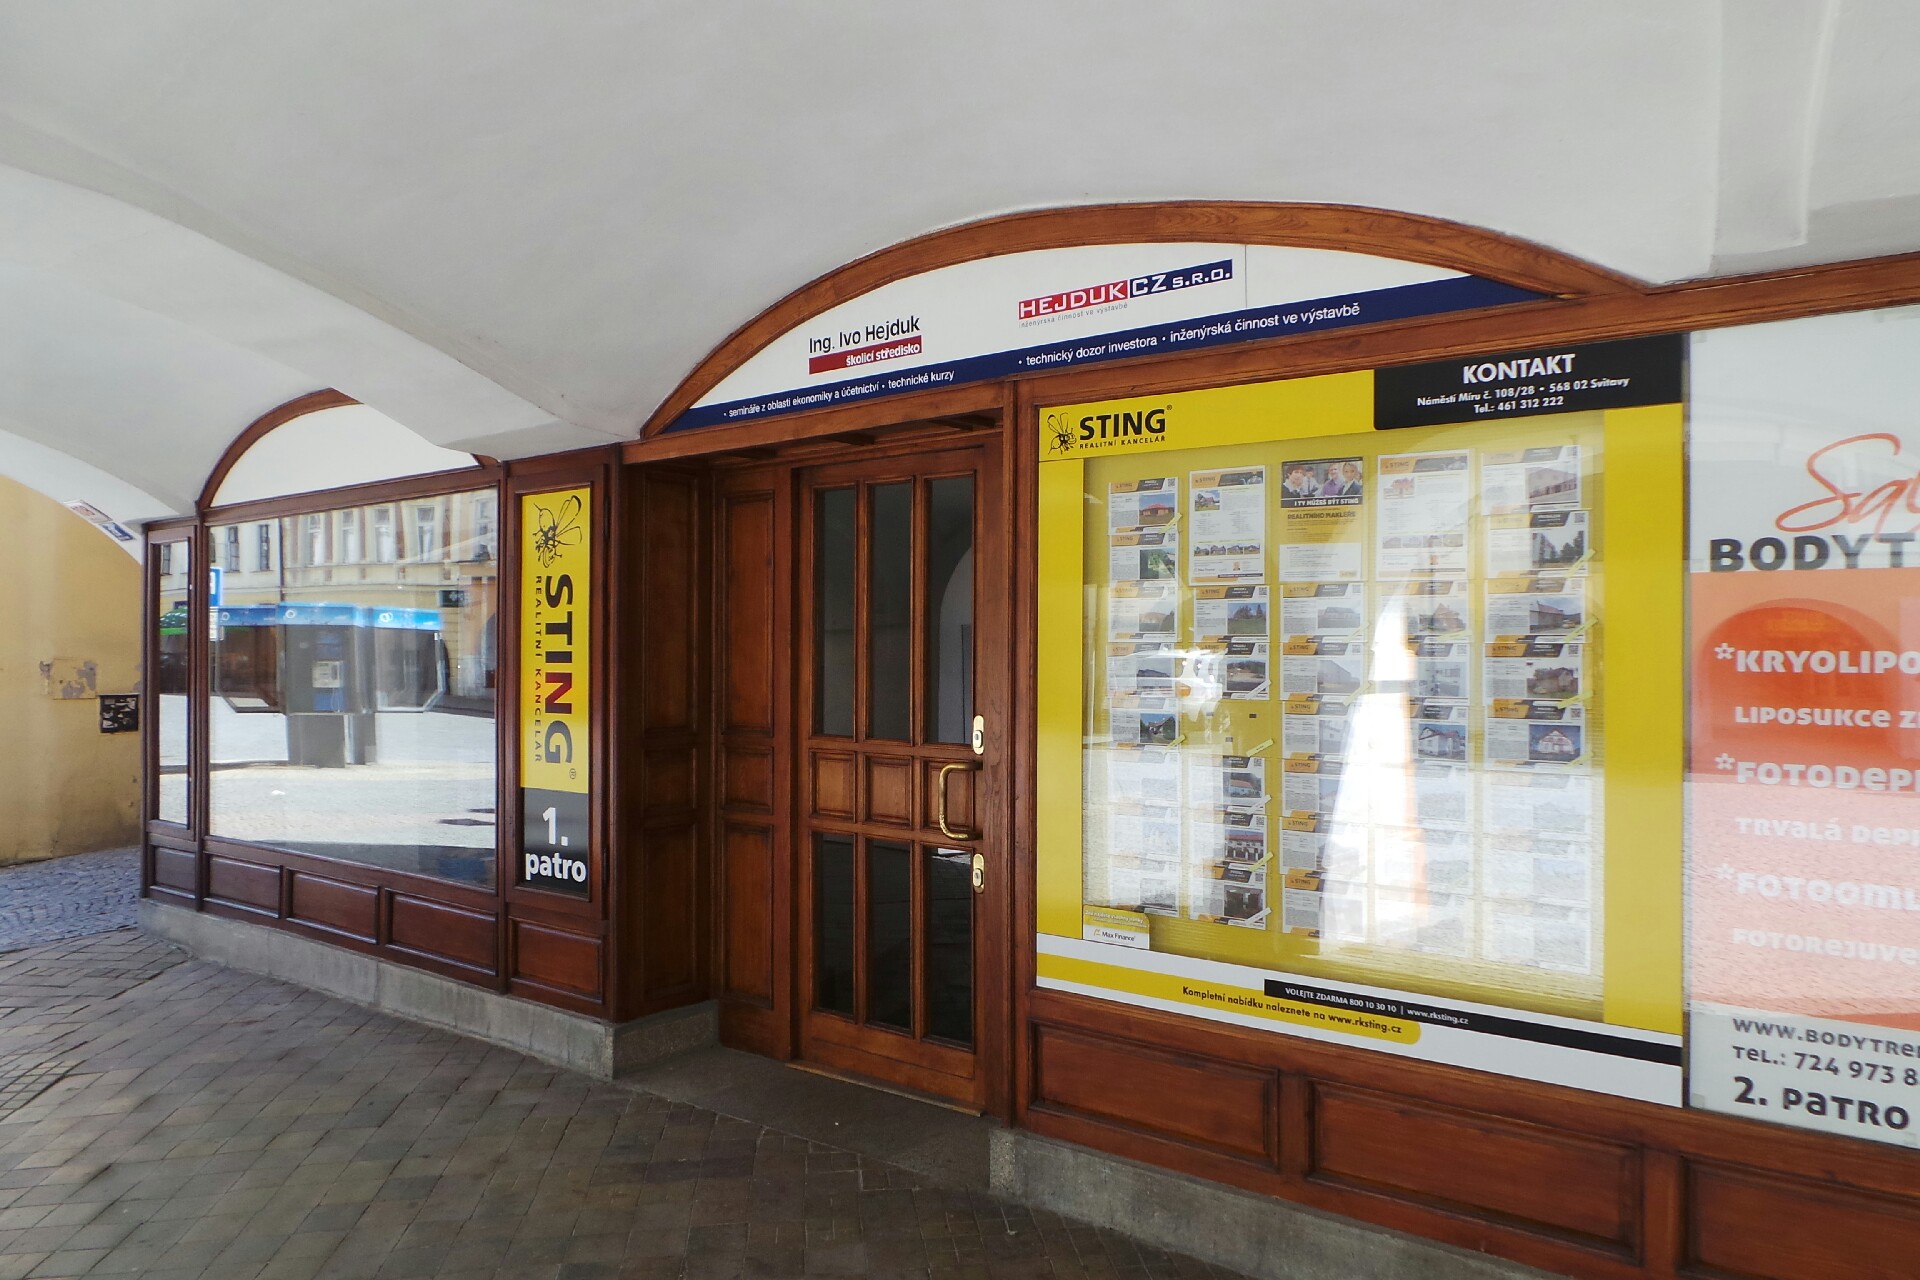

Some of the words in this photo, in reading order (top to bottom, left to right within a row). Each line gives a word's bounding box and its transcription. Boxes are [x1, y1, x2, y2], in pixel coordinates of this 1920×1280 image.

[1019, 282, 1126, 319] HEJDUK
[1132, 274, 1166, 296] CZ
[809, 337, 835, 354] Ing.
[839, 330, 860, 348] Ivo
[865, 315, 920, 344] Hejduk
[1026, 349, 1074, 367] technický
[1076, 344, 1106, 359] dozor
[1108, 335, 1158, 354] investora
[1170, 320, 1232, 343] inženýrská
[1235, 314, 1279, 331] činnost
[1283, 313, 1298, 325] ve
[1300, 302, 1360, 324] výstavbě
[845, 351, 874, 367] školicí
[875, 342, 920, 361] středisko
[1463, 353, 1576, 384] KONTAKT
[728, 403, 760, 417] semináře
[761, 402, 766, 411] z
[767, 396, 791, 411] oblasti
[792, 390, 833, 406] ekonomiky
[834, 390, 840, 399] a
[841, 381, 879, 398] účetnictví
[888, 372, 929, 389] technické
[930, 369, 954, 386] kurzy
[1417, 393, 1456, 406] Náměstí
[1495, 385, 1535, 399] 108/28
[1549, 382, 1572, 393] 568
[1574, 380, 1588, 391] 02
[1590, 377, 1631, 389] Svitavy
[1497, 401, 1516, 412] 461
[1520, 398, 1540, 409] 312
[1543, 396, 1564, 406] 222
[1079, 408, 1166, 441] STING
[1079, 440, 1117, 450] REALITNÍ
[1120, 435, 1166, 447] KANCELÁŘ
[1709, 532, 1915, 572] BODYT
[534, 575, 543, 658] REALITNÍ
[544, 573, 574, 764] STING
[534, 668, 543, 763] KANCELÁŘ
[1898, 710, 1920, 728] z
[542, 807, 568, 847] 1.
[525, 852, 586, 882] patro
[1182, 985, 1225, 1003] Kompletní
[1228, 994, 1263, 1010] nabídku
[1266, 1001, 1311, 1018] naleznete
[1313, 1010, 1326, 1020] na
[1328, 1013, 1403, 1035] www.rksting.cz
[1285, 987, 1314, 999] VOLEJTE
[1316, 991, 1348, 1005] ZDARMA
[1349, 998, 1364, 1008] 800
[1365, 1000, 1374, 1009] 10
[1376, 1002, 1385, 1011] 30
[1387, 1003, 1397, 1013] 10
[1407, 1008, 1469, 1026] www.rksting.cz
[1794, 1052, 1840, 1076] 724
[1849, 1061, 1895, 1084] 973
[1904, 1068, 1918, 1085] 8
[1734, 1076, 1768, 1106] 2.
